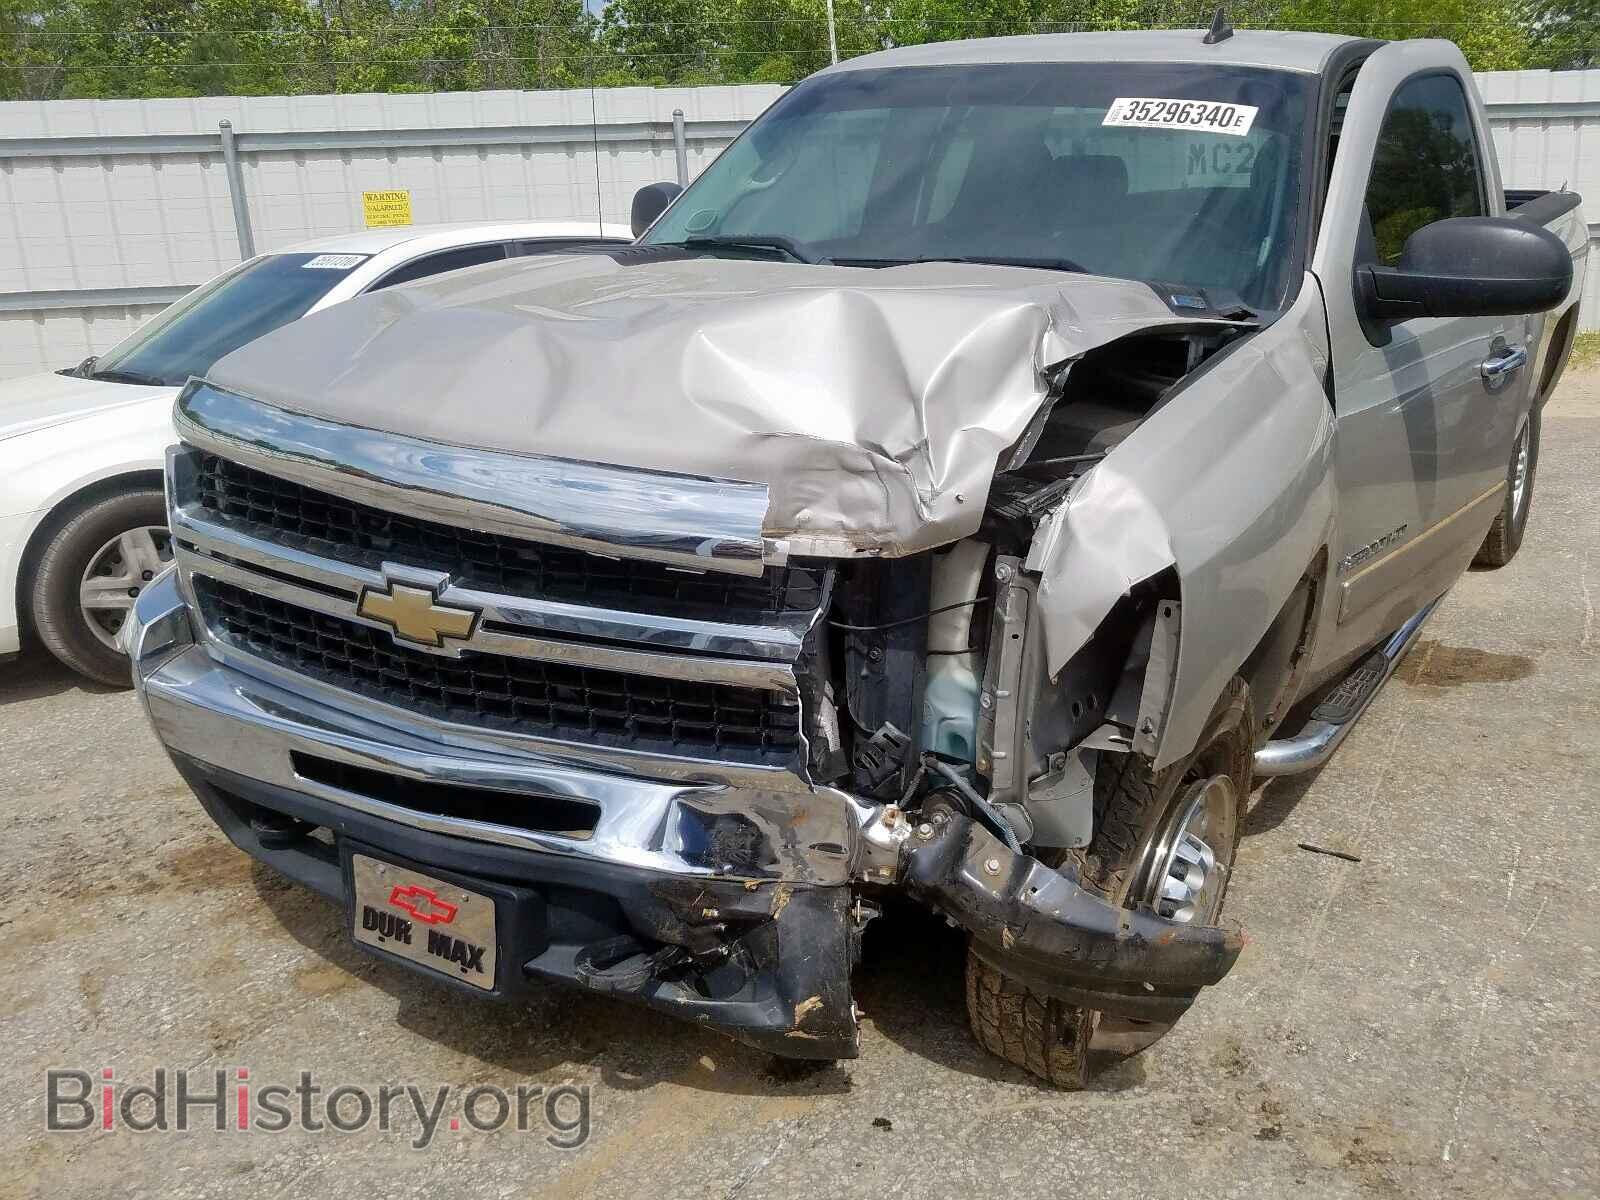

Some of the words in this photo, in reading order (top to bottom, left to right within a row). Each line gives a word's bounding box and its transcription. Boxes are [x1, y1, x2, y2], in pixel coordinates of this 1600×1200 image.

[1122, 100, 1236, 128] 35296340
[1234, 115, 1246, 127] E
[366, 192, 407, 201] WARNING
[427, 928, 487, 974] MAX
